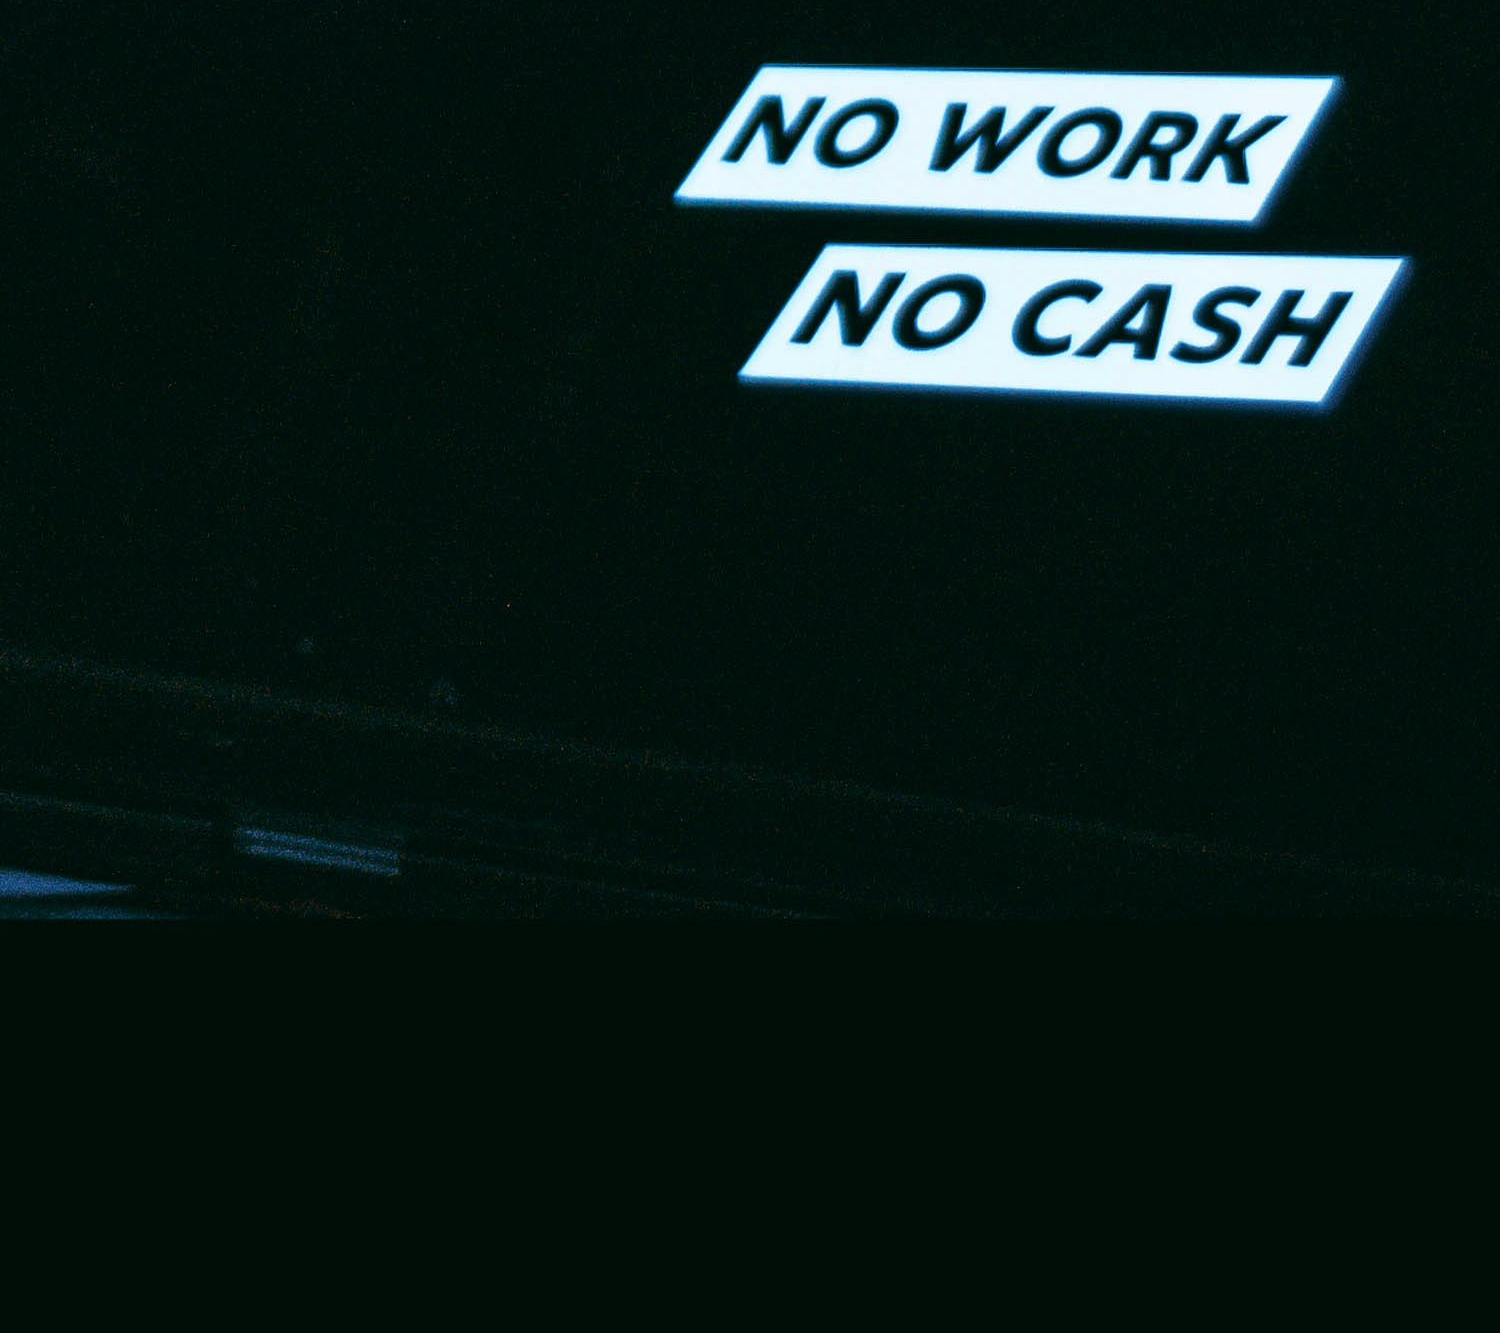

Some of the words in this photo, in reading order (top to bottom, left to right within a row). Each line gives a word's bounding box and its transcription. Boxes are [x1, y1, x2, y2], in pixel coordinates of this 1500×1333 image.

[719, 94, 901, 169] NO
[926, 100, 1291, 186] WORK
[788, 269, 988, 352] NO
[1009, 277, 1355, 369] CASH
